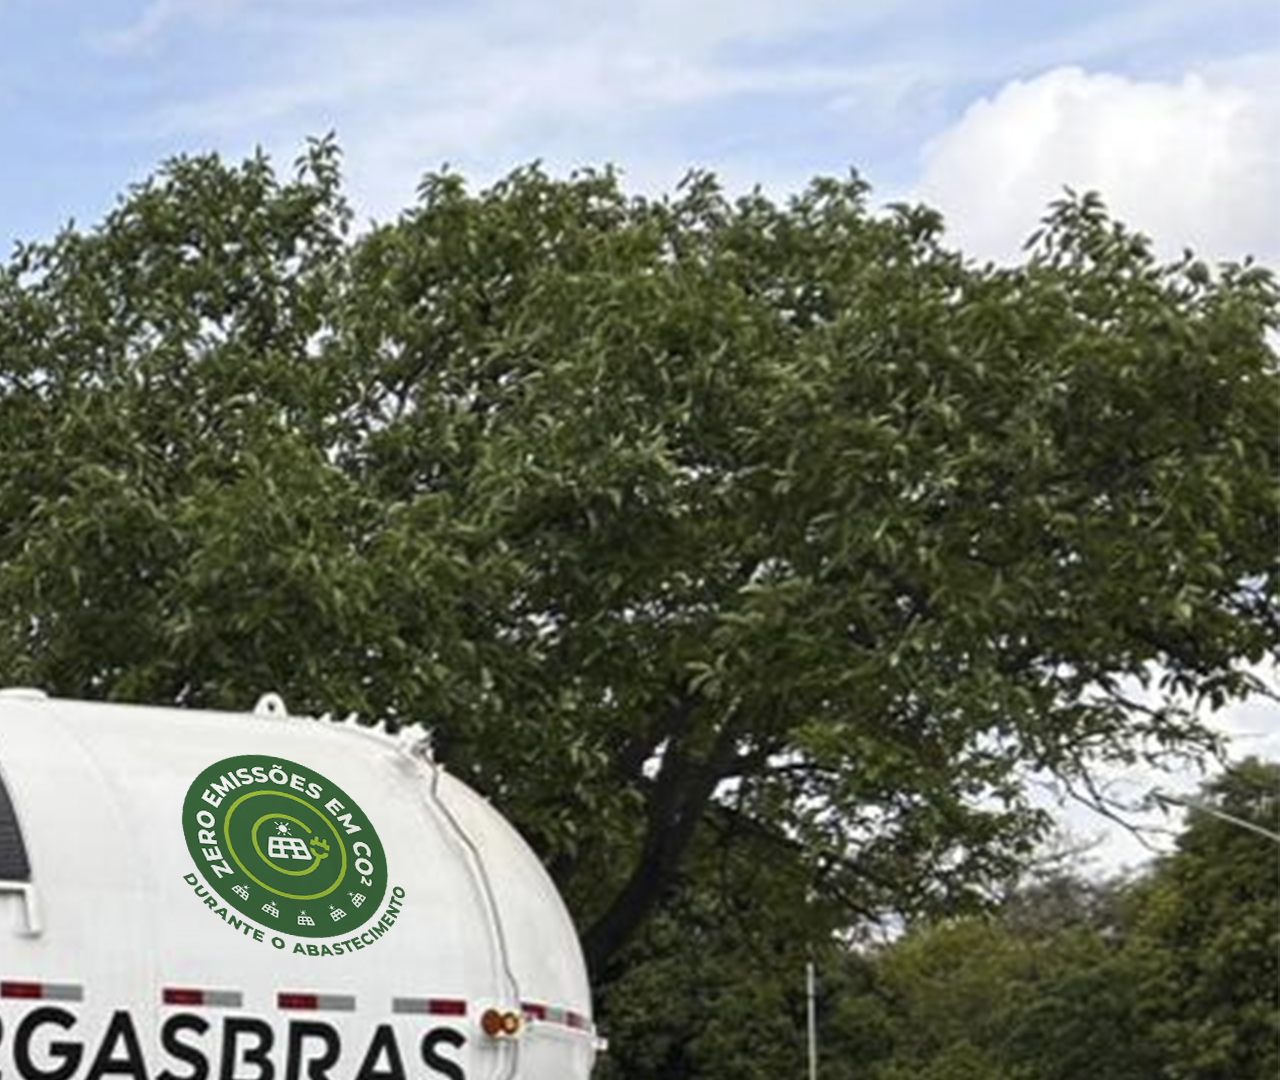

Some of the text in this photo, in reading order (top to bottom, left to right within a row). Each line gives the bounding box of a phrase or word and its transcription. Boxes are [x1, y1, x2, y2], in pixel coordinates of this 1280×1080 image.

[200, 764, 324, 809] EMISSÕES
[195, 809, 235, 879] ZERO
[323, 797, 362, 835] EM
[182, 872, 406, 957] DURANTE O ABASTECIMENTO
